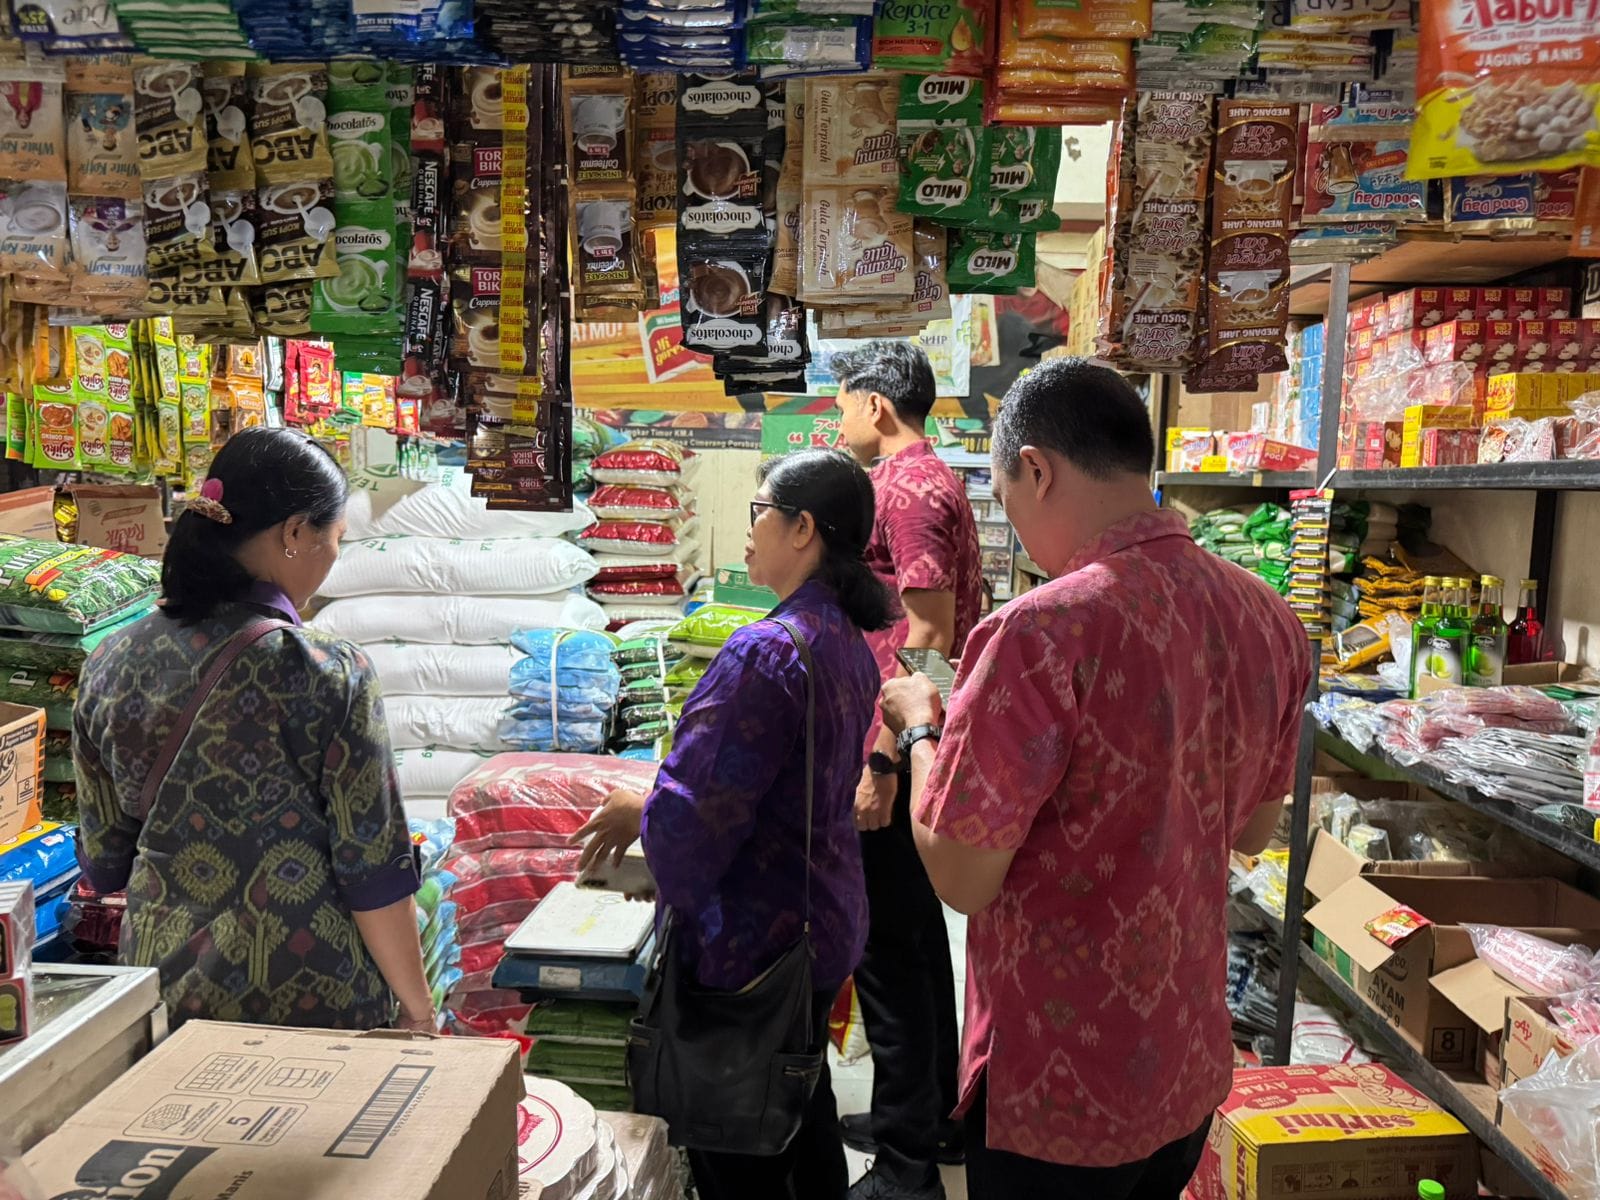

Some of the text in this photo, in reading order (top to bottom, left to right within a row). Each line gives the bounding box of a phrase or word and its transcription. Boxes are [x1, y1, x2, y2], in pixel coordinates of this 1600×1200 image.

[880, 0, 951, 22] Rejoice
[1474, 46, 1584, 68] JAGUNG MANIS
[923, 78, 966, 96] MILO
[1227, 107, 1291, 118] WEDANG JAHE
[817, 90, 832, 164] Gula Terpisah
[139, 125, 194, 160] ABC
[863, 130, 898, 150] Latte
[253, 133, 319, 167] ABC
[853, 149, 898, 167] reamy
[478, 162, 501, 172] BIK
[579, 159, 621, 170] Coffeemix
[423, 161, 438, 214] NESCAFE
[921, 183, 964, 200] MILO
[1143, 202, 1197, 214] SUSU JAHE
[1352, 191, 1421, 209] Good Day
[1461, 197, 1529, 215] Good Day
[818, 199, 831, 225] Gula
[1221, 219, 1284, 230] WEDANG JAHE
[263, 244, 327, 275] ABC
[862, 241, 897, 263] Latte
[180, 256, 247, 284] ABC
[853, 257, 907, 280] Creamy
[973, 255, 1012, 270] MILO
[147, 280, 213, 306] ABC
[477, 281, 500, 292] BIK
[415, 287, 433, 340] NESCAFE
[1133, 313, 1187, 323] SUSU JAHE
[1217, 327, 1281, 340] WEDANG JAHE
[42, 442, 75, 458] Sajiku
[24, 779, 30, 791] 8
[1372, 973, 1406, 1012] AYAM
[1440, 1031, 1457, 1048] 8
[1234, 1080, 1289, 1096] AYAM
[226, 1115, 253, 1128] 5
[1272, 1114, 1416, 1136] sarimi
